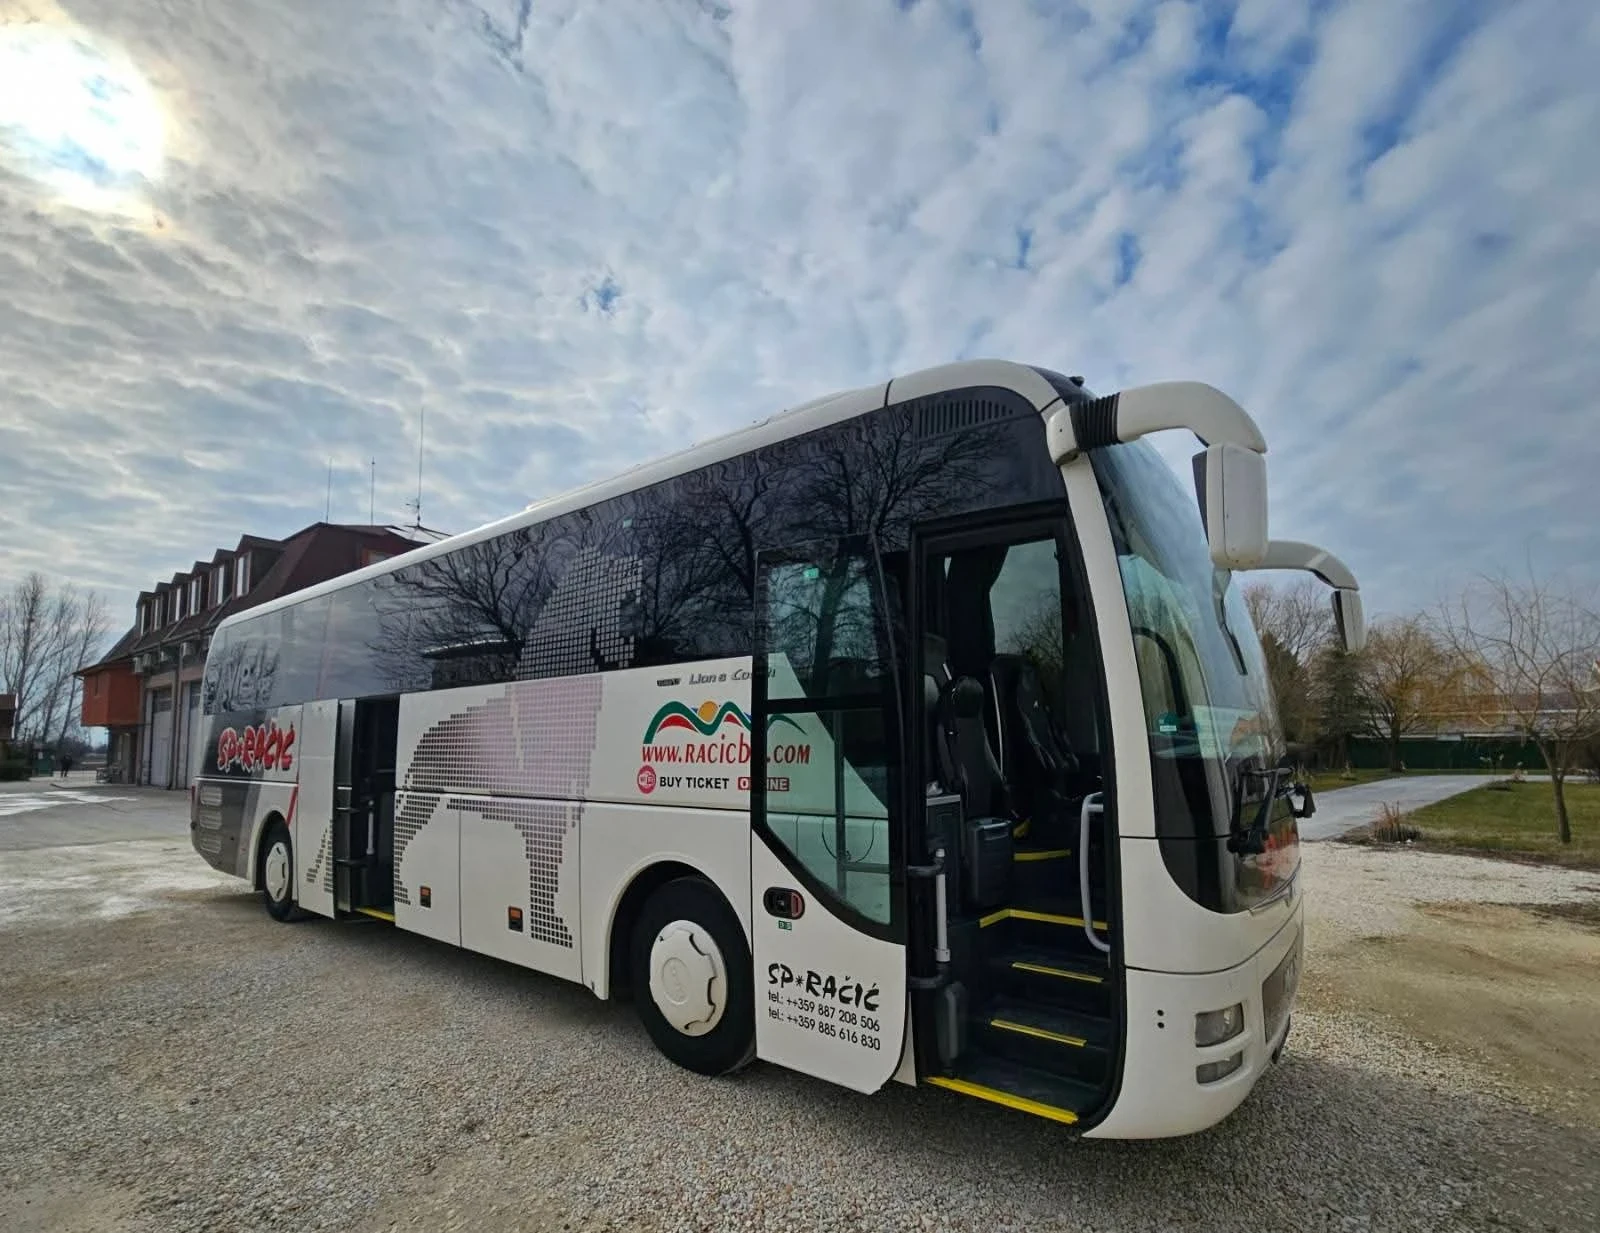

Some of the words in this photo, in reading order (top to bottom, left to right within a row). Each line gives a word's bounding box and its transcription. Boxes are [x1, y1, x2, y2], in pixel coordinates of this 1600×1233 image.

[659, 776, 682, 788] BUY
[687, 777, 730, 790] TICKET
[739, 777, 789, 791] OINE
[818, 1004, 836, 1019] 887
[838, 1009, 858, 1025] 208
[860, 1015, 880, 1032] 506
[818, 1021, 836, 1037] 885
[839, 1027, 858, 1043] 616
[860, 1034, 880, 1051] 830
